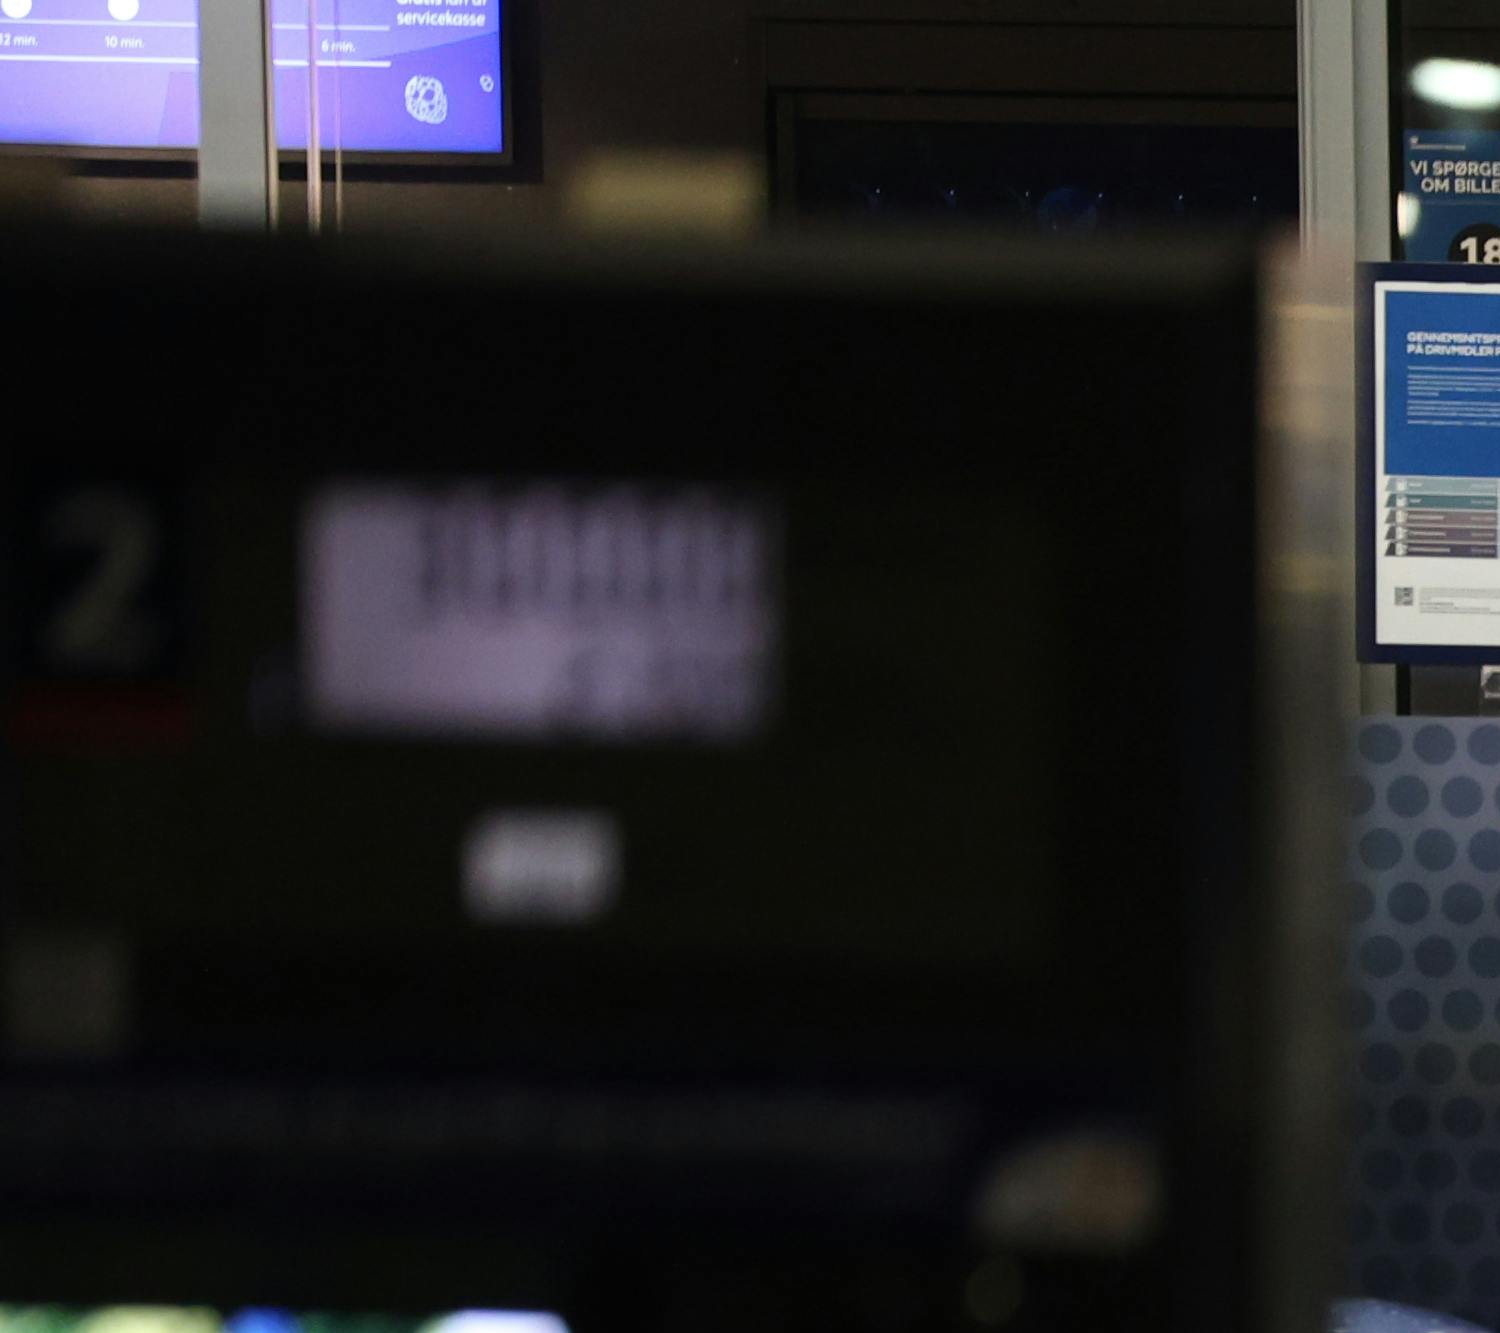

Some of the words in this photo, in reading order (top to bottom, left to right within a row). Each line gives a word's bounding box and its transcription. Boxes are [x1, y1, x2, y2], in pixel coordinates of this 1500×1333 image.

[396, 11, 486, 28] servicekasse
[105, 36, 117, 48] 10
[119, 37, 145, 49] min.
[1410, 160, 1430, 177] VI
[1420, 177, 1451, 194] OM
